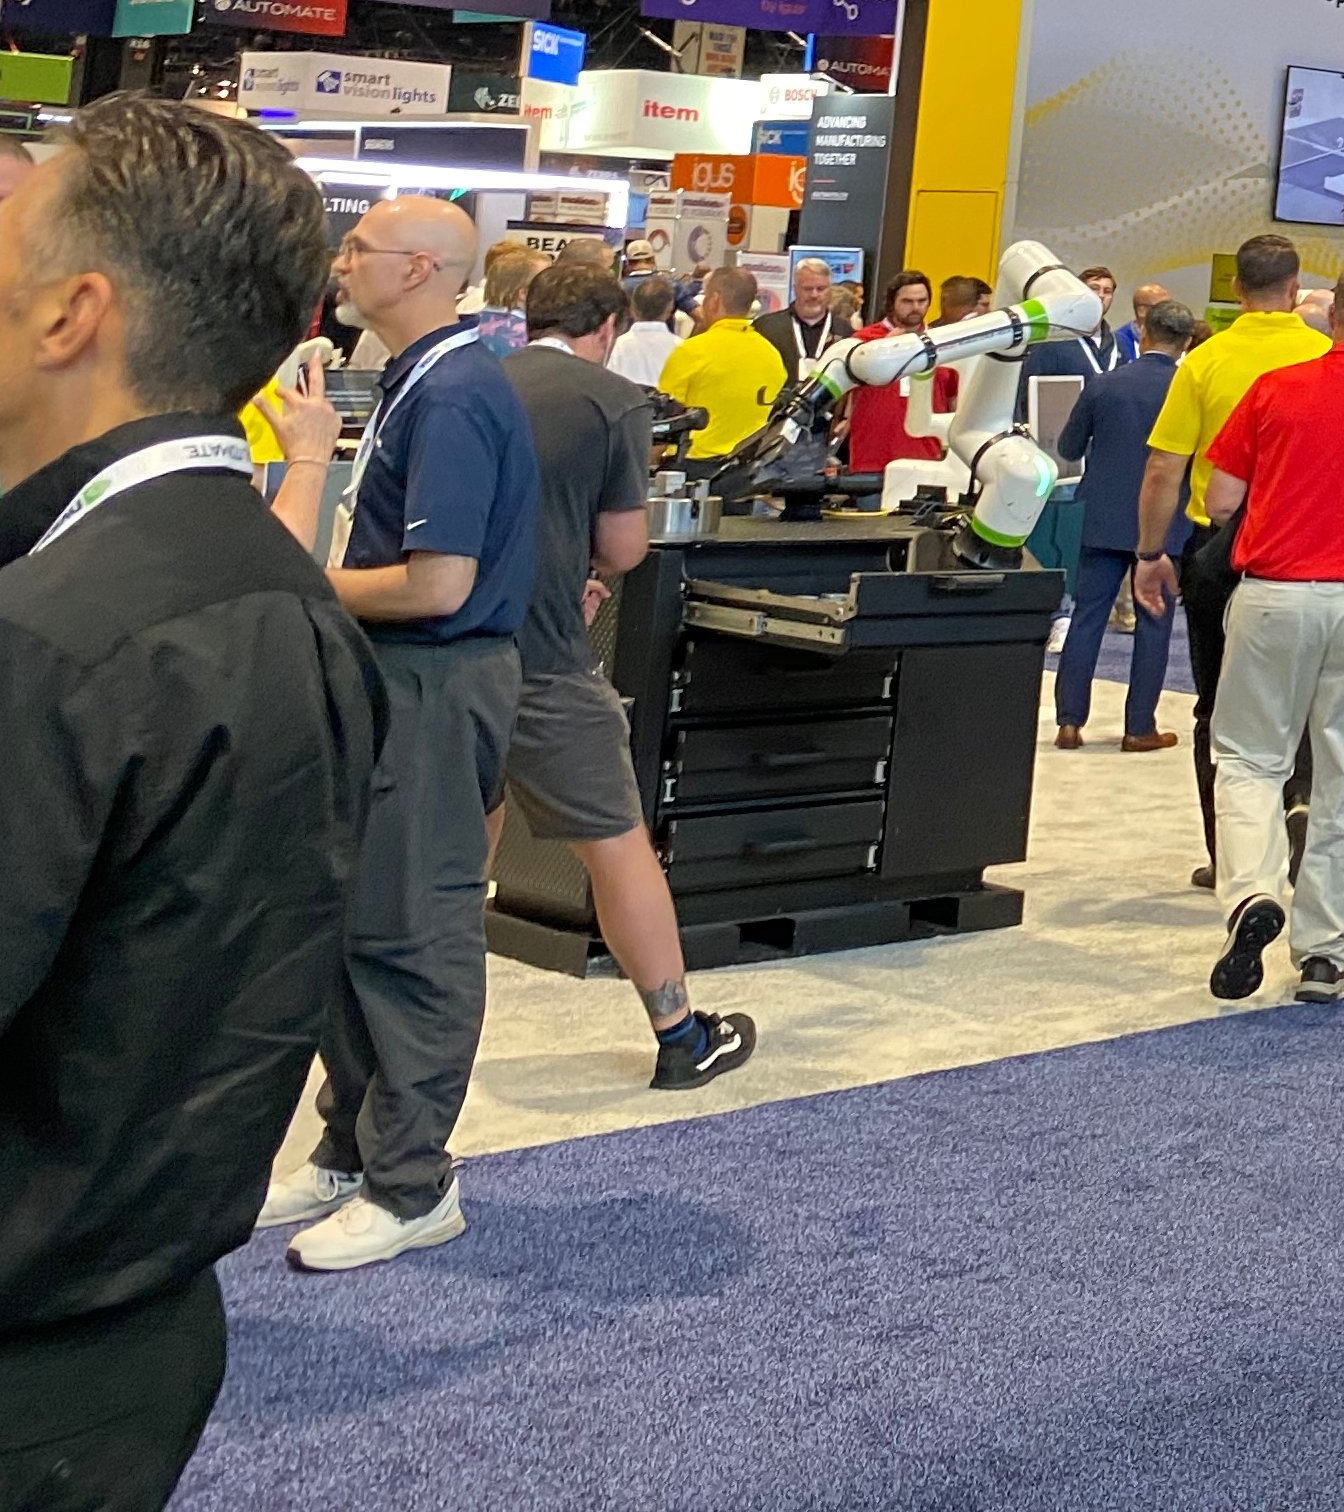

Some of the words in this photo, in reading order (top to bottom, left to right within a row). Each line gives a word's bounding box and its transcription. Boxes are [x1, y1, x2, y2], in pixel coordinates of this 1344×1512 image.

[233, 0, 337, 22] AUTOMATE
[533, 30, 560, 55] SICK
[344, 72, 390, 85] smart
[784, 88, 817, 102] BOSCH
[642, 100, 700, 122] item
[813, 152, 857, 166] TOGETHER
[323, 199, 370, 214] LTING
[527, 237, 568, 251] BEA
